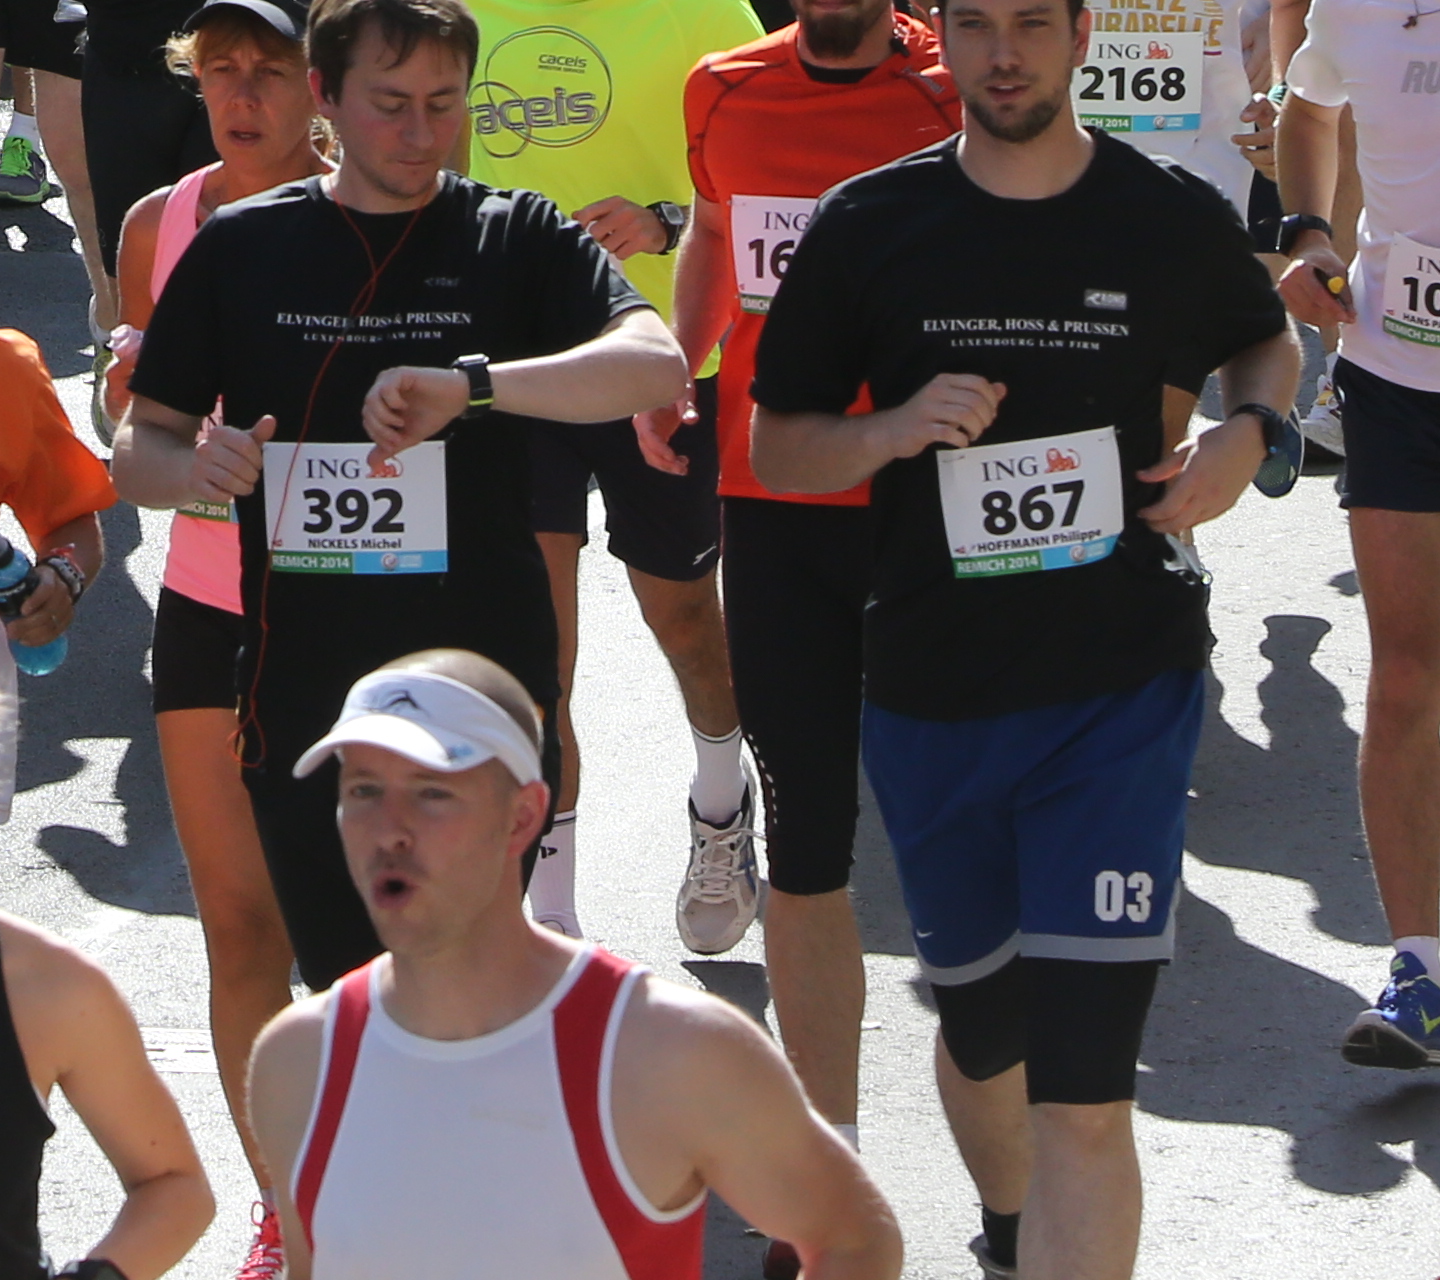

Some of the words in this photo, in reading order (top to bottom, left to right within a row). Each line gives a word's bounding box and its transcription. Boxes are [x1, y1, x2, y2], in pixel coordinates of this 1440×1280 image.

[1098, 42, 1141, 60] ING
[538, 53, 587, 69] caceis
[1080, 65, 1186, 102] 2168
[1104, 117, 1130, 128] 2014
[764, 210, 810, 232] ING
[406, 311, 472, 326] PRUSSEN
[922, 318, 1000, 334] ELVINGER,
[1005, 319, 1043, 334] HOSS
[1046, 321, 1058, 334] &
[1062, 321, 1129, 337] PRUSSEN
[1403, 312, 1431, 328] HANS
[414, 330, 443, 340] FIRM
[1384, 320, 1422, 339] REMICH
[950, 338, 1031, 349] LUXEMBOURG
[1036, 340, 1063, 350] LAW
[1064, 341, 1100, 351] FIRM
[305, 456, 360, 480] ING
[981, 458, 1038, 484] ING
[205, 503, 229, 517] 2014
[302, 487, 405, 534] 392
[980, 481, 1086, 537] 867
[307, 537, 358, 551] NICKELS
[360, 536, 403, 550] Michel
[977, 534, 1050, 553] HOFFMANN
[1051, 527, 1102, 545] Philippe
[272, 555, 317, 569] REMICH
[319, 555, 351, 568] 2014
[957, 556, 1007, 573] REMICH
[1008, 553, 1040, 569] 2014
[1094, 870, 1154, 922] 03
